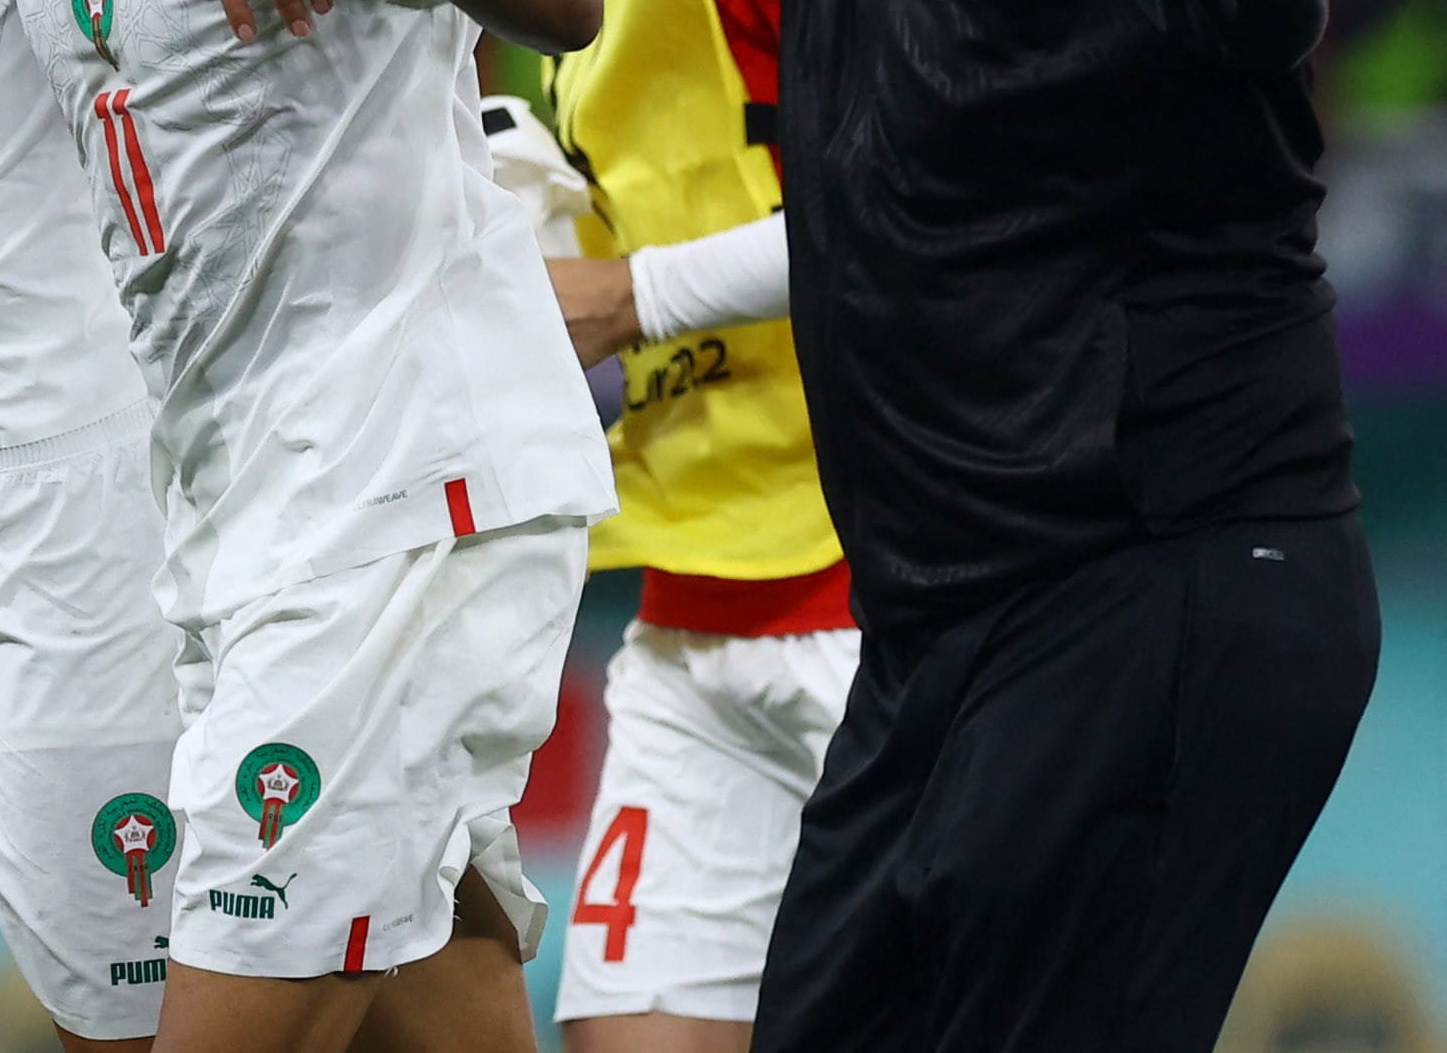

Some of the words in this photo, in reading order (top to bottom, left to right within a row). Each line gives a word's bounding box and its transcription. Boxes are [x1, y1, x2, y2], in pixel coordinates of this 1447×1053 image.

[93, 88, 165, 256] 11
[209, 889, 275, 919] PUMA
[573, 807, 648, 963] 4
[110, 958, 168, 986] PUM
